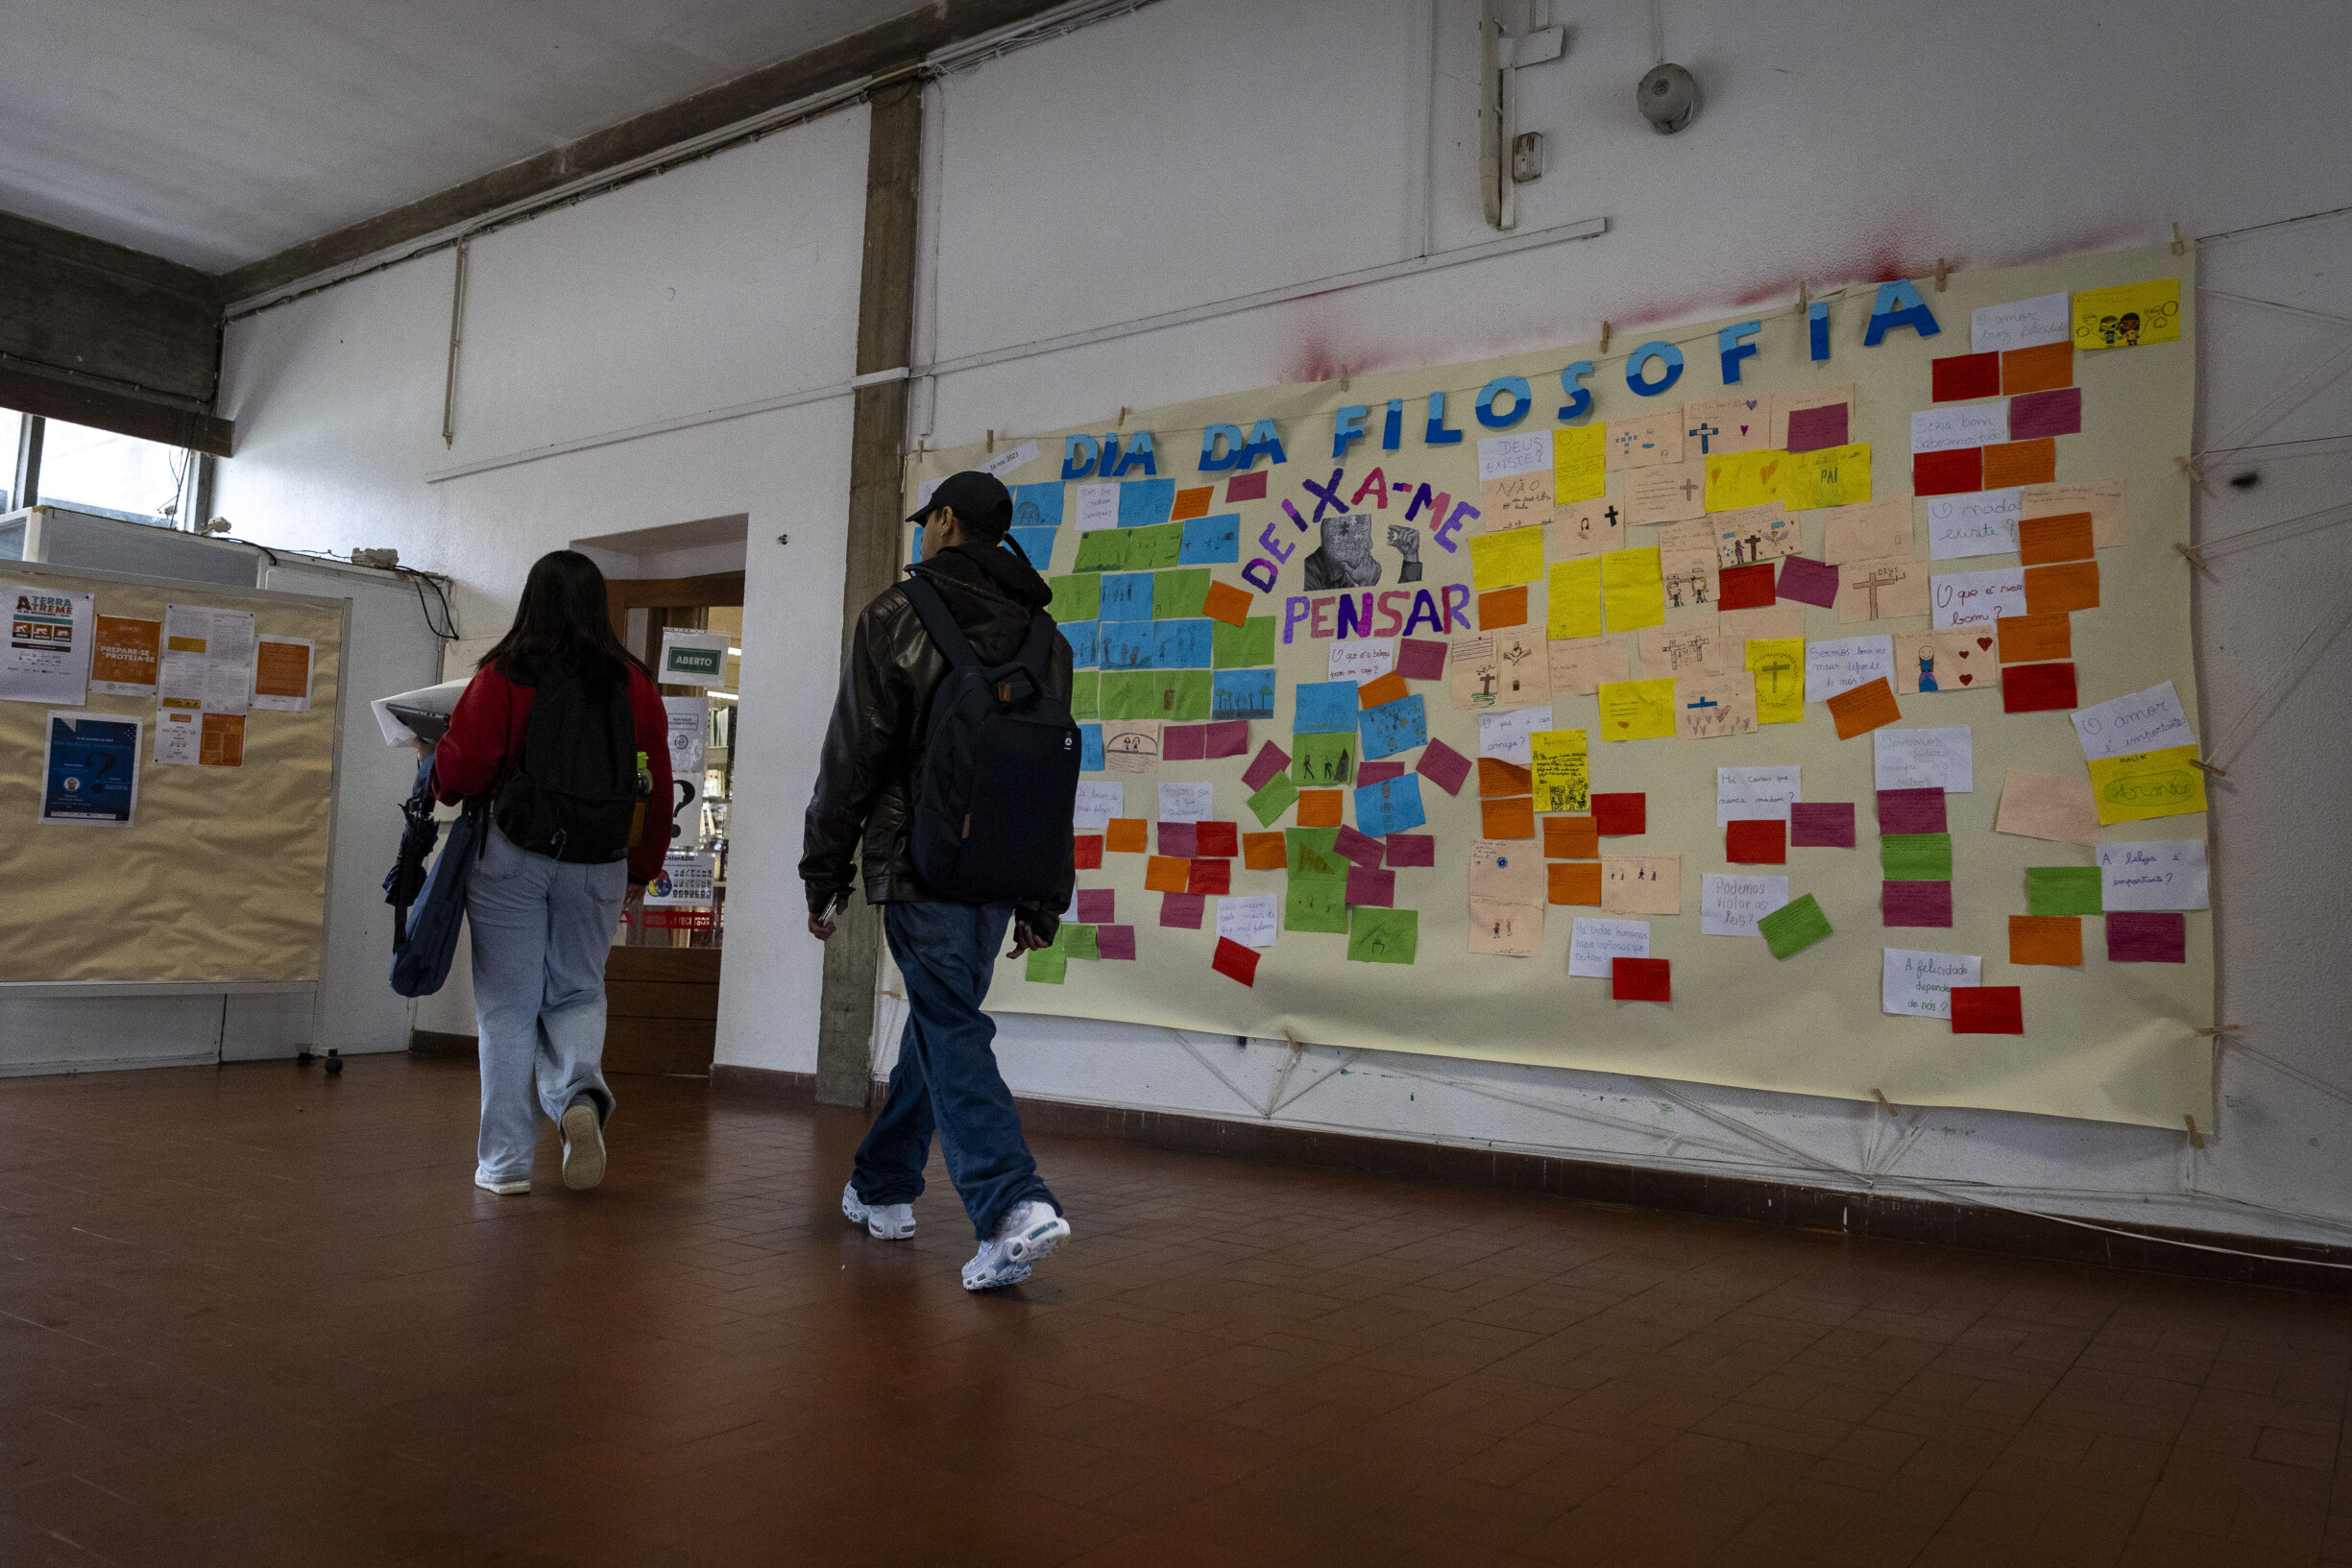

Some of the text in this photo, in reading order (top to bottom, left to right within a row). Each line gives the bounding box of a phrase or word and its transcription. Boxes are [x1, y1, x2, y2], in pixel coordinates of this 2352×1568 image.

[1060, 277, 1940, 480] DIA DA FILOSOFIA
[1499, 437, 1543, 455] DEUS
[1241, 467, 1481, 593] DEIXA-ME
[32, 595, 72, 607] TERRA
[32, 603, 74, 615] TREME
[1283, 584, 1471, 645] PENSAR
[100, 645, 151, 657] PREPARE-SE
[106, 652, 156, 663] PROTEJA-SE
[675, 655, 713, 666] ABERTO
[2102, 852, 2112, 865] A
[1714, 876, 1765, 895] Podemos
[1717, 895, 1750, 909] violar
[1904, 956, 1912, 971] A
